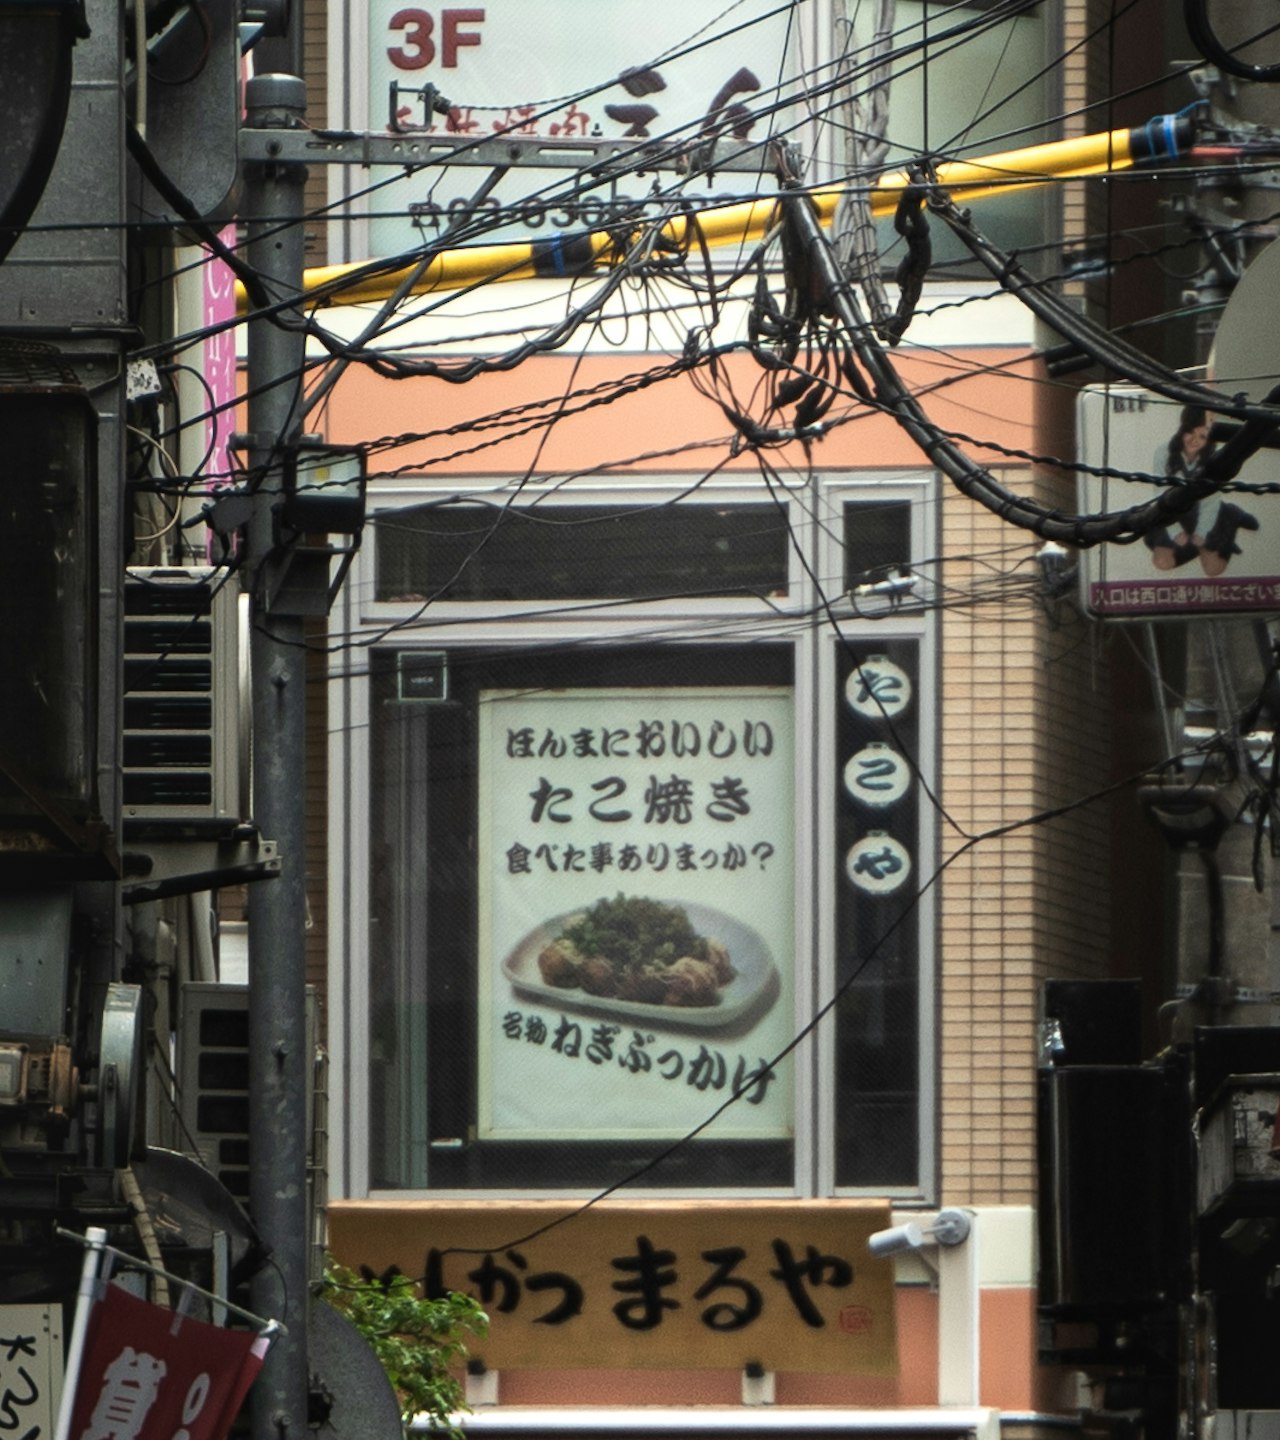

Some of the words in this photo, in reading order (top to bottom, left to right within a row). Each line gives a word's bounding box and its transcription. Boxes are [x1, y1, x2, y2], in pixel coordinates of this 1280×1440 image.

[386, 8, 485, 71] 3F
[506, 720, 774, 759] ほんまにおいしい
[529, 773, 752, 825] たこ焼き
[506, 841, 774, 874] 食べた事ありまっか?
[551, 1014, 777, 1106] ねぎぶっかけ
